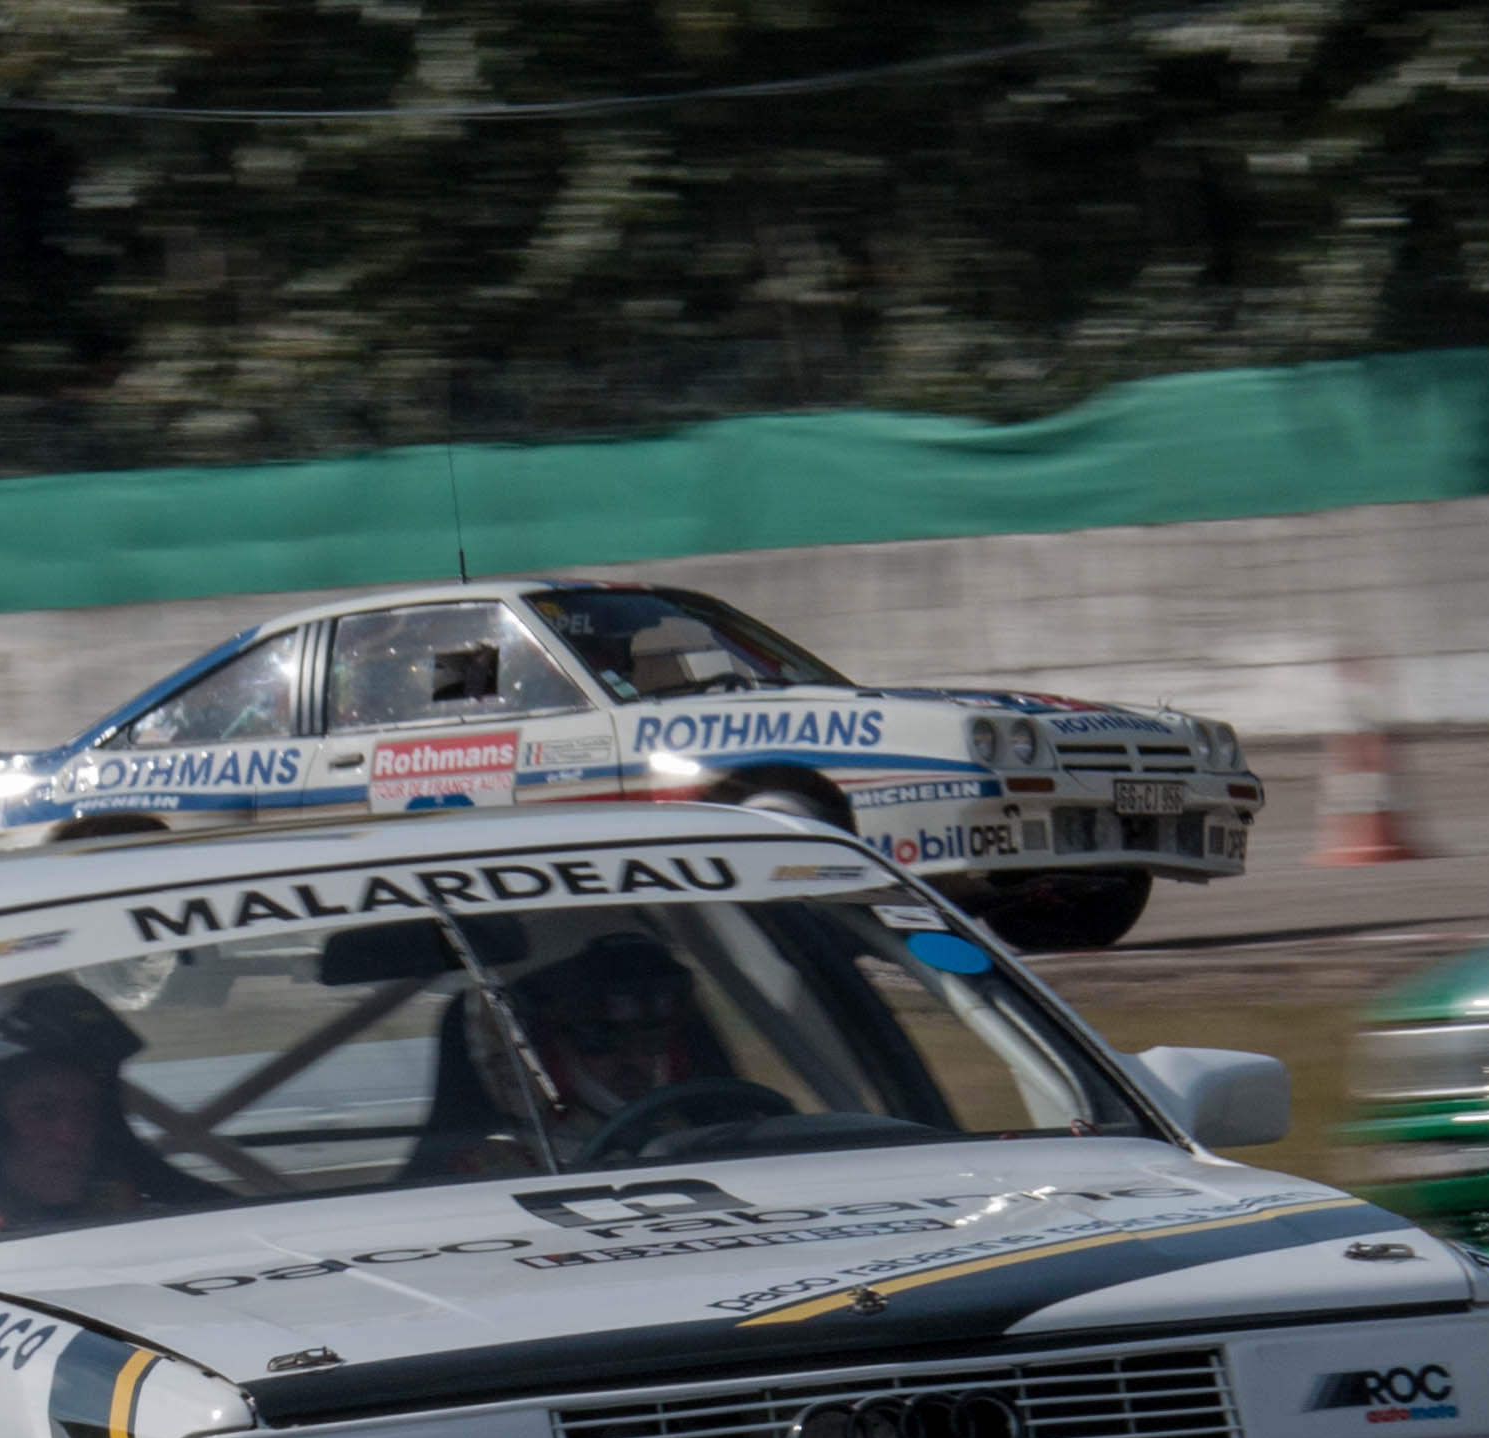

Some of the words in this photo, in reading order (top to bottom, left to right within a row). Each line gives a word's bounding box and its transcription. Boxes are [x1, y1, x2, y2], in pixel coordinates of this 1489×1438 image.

[634, 710, 883, 752] ROTHMANS
[1051, 713, 1173, 735] ROTHMANS
[375, 743, 514, 776] Rothmans
[852, 781, 982, 807] MICHELIN
[969, 825, 1018, 857] OPEL
[129, 857, 739, 942] MALARDEAU
[161, 1238, 533, 1296] paco
[705, 1275, 839, 1313] paco
[837, 1230, 1045, 1278] rabanne
[1361, 1364, 1453, 1405] ROC
